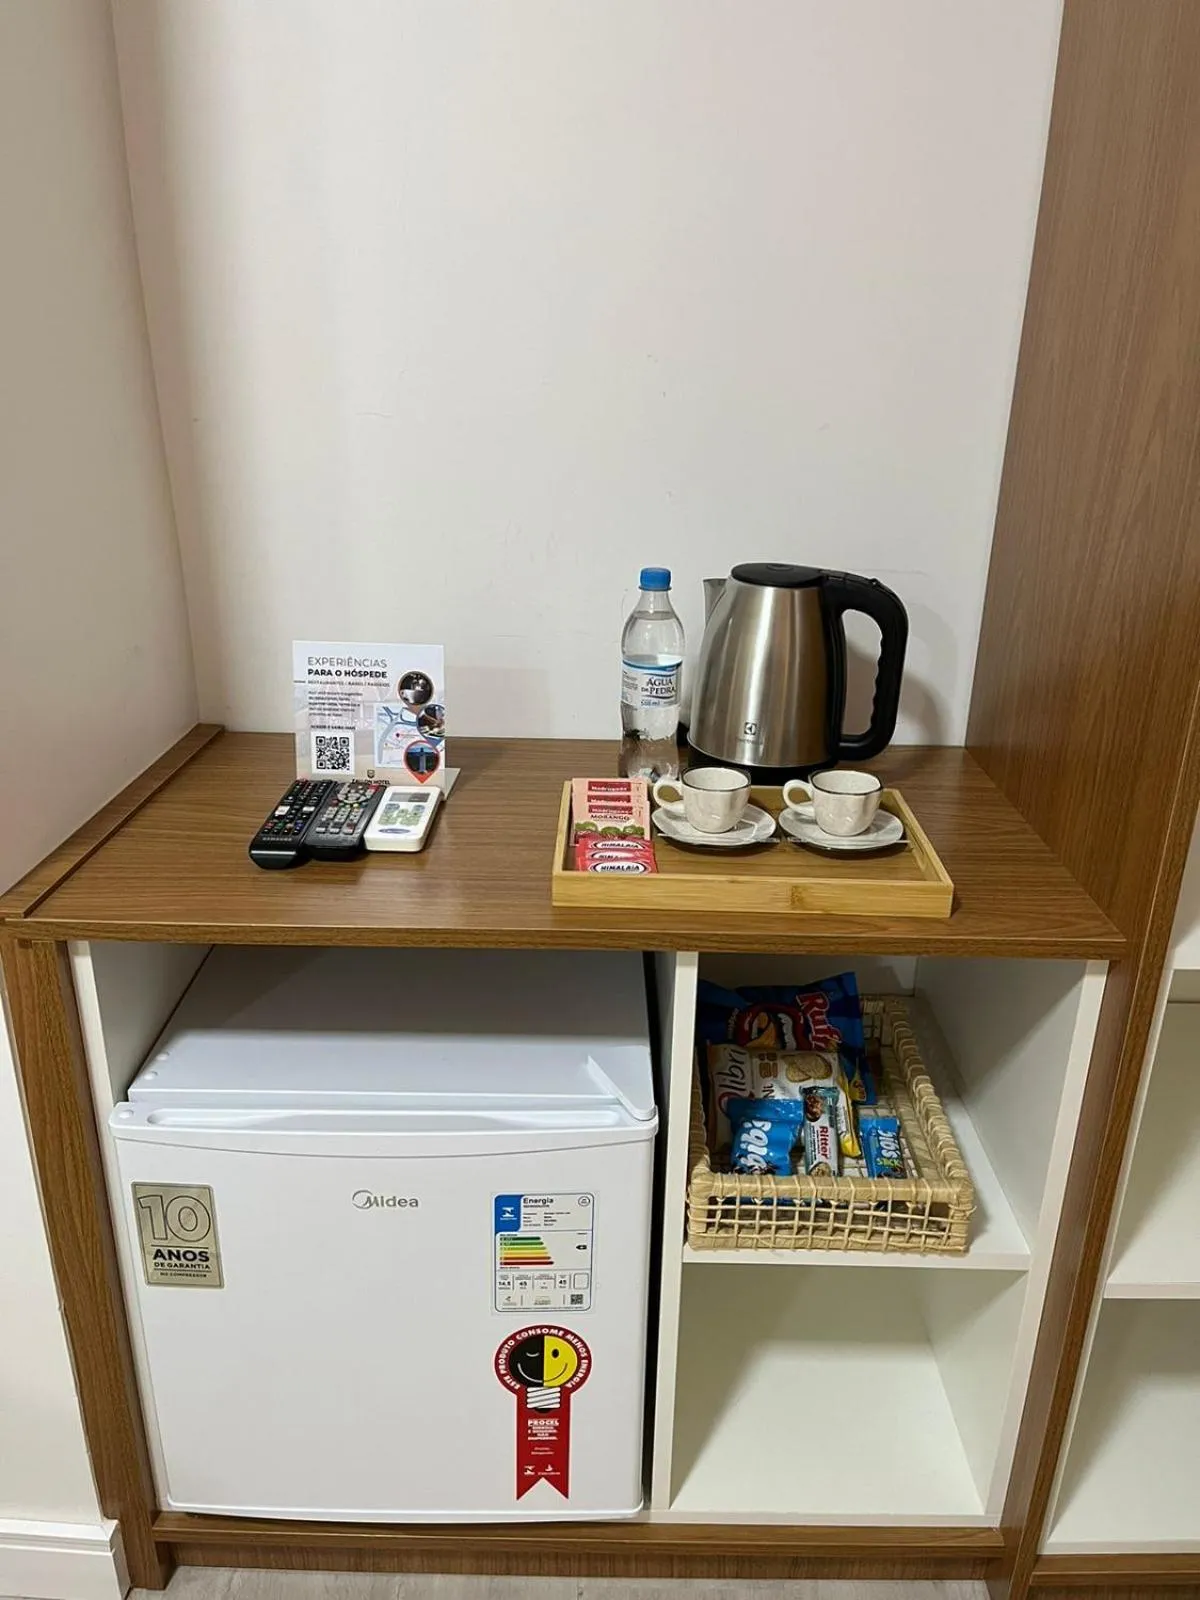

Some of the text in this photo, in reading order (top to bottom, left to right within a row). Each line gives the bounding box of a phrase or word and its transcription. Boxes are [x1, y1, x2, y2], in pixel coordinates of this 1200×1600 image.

[307, 656, 388, 669] EXPERIÊNCIAS
[307, 668, 388, 679] PARA O HÓSPEDE
[646, 676, 673, 687] ÁGUA
[600, 864, 641, 872] HIMALAIA
[819, 1126, 831, 1160] Ritter
[354, 1191, 419, 1209] Midea
[523, 1197, 554, 1205] Energia
[137, 1193, 211, 1243] 10
[153, 1248, 210, 1262] ANOS
[154, 1261, 211, 1270] DE GARANTIA
[498, 1327, 589, 1391] ESTE PRODUTO CONSOME MENOS ENERGIA
[527, 1418, 560, 1427] PROCEL
